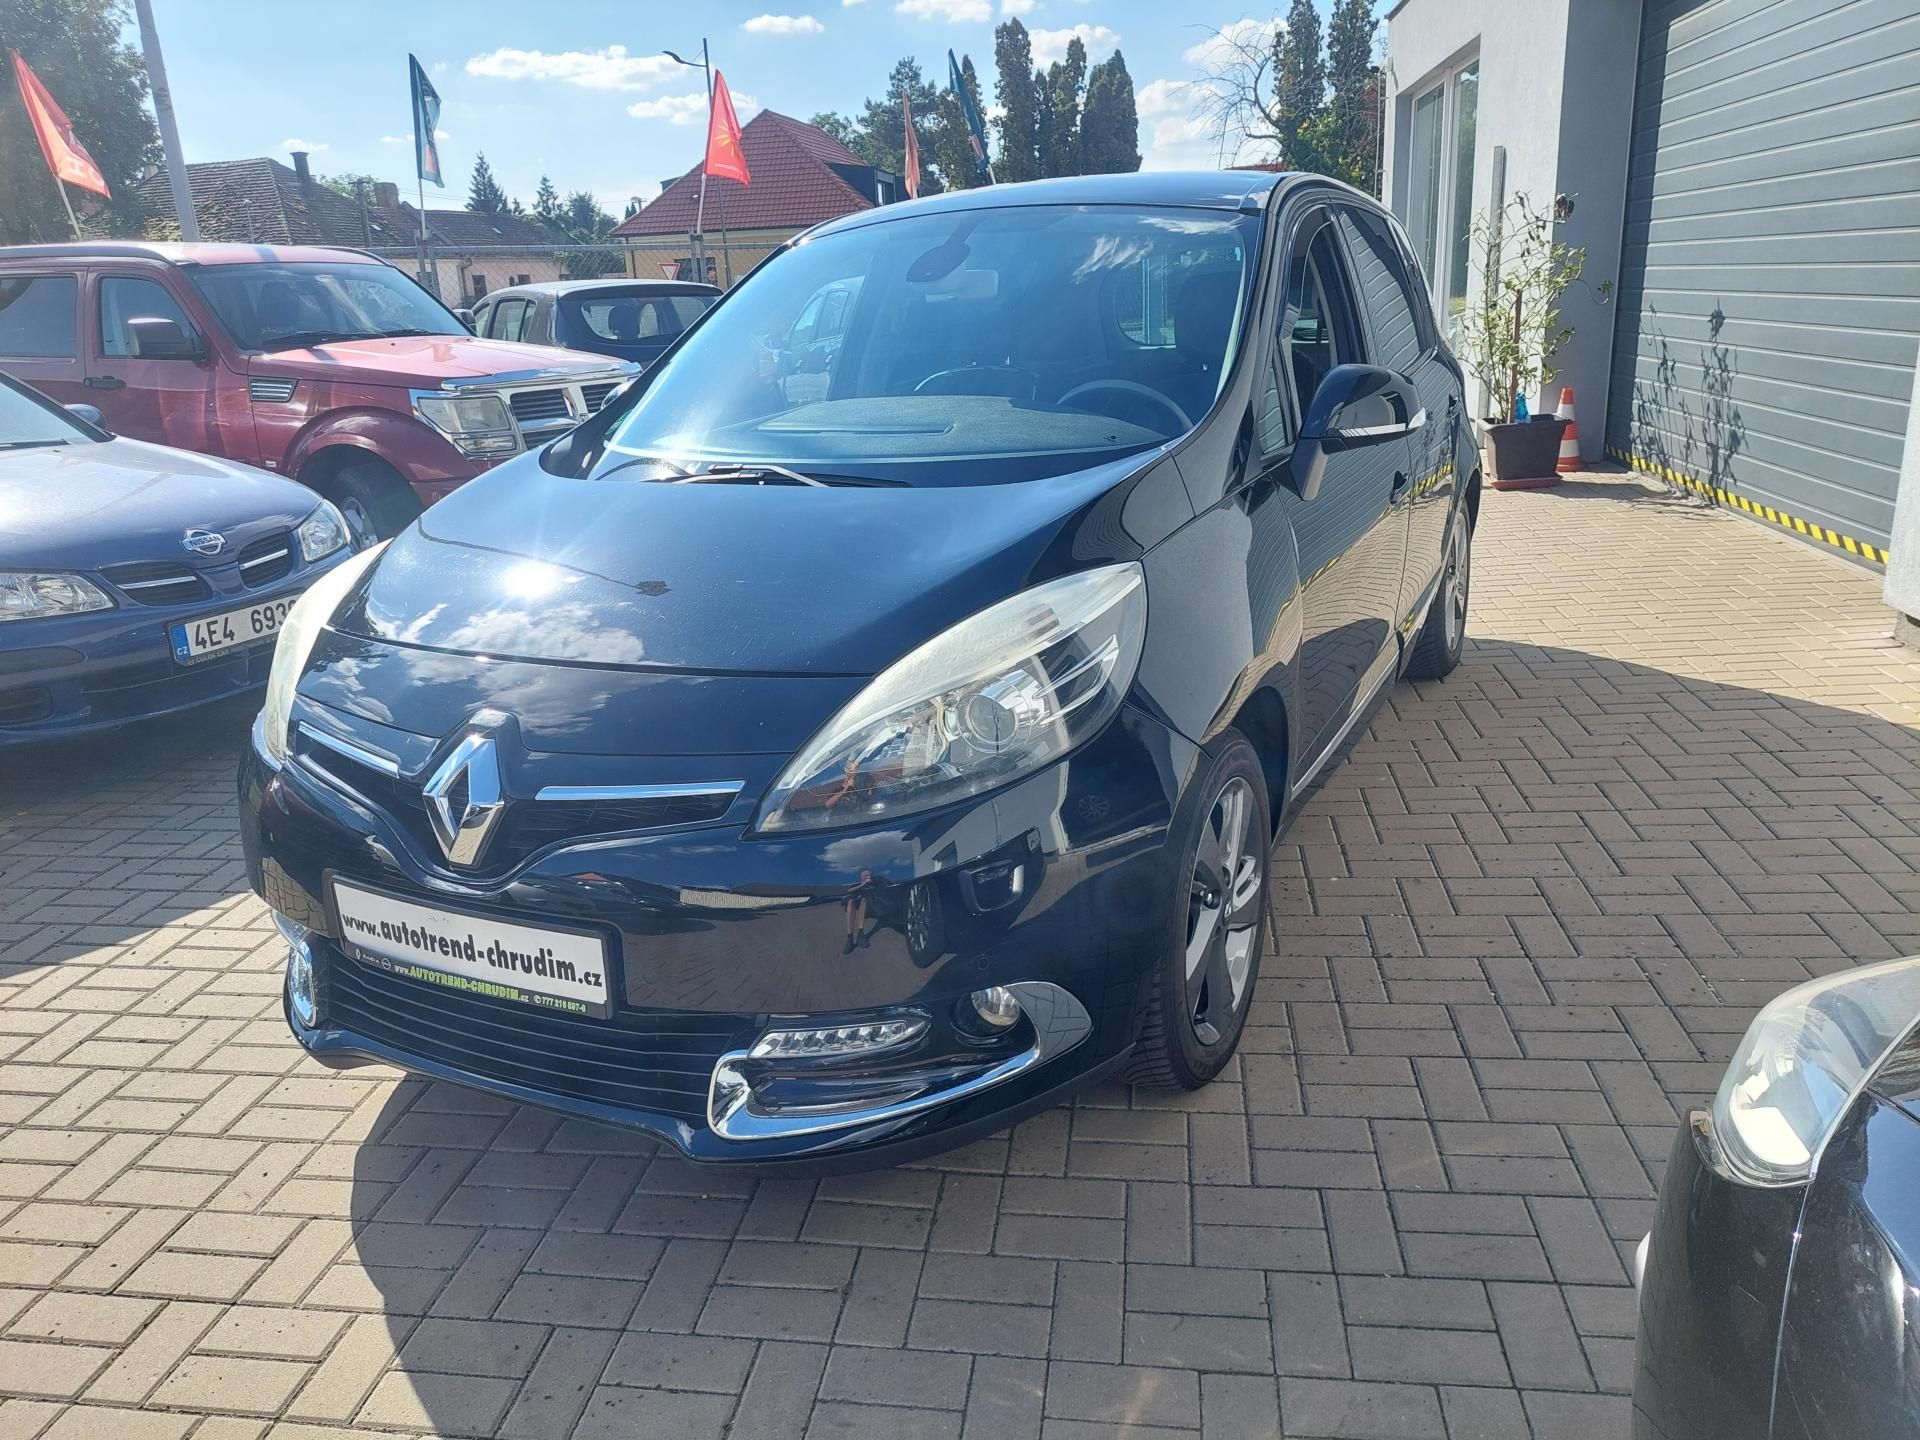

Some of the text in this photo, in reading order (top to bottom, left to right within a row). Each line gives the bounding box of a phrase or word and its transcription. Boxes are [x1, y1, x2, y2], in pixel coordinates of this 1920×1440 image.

[188, 534, 221, 547] NISSAN
[194, 617, 236, 650] 4E4
[177, 646, 189, 656] CZ
[342, 913, 603, 988] www.autotrend-chrudim.cz
[394, 964, 529, 1003] www.AUTOTREND-CHRUDIM.cz
[542, 996, 554, 1006] 777
